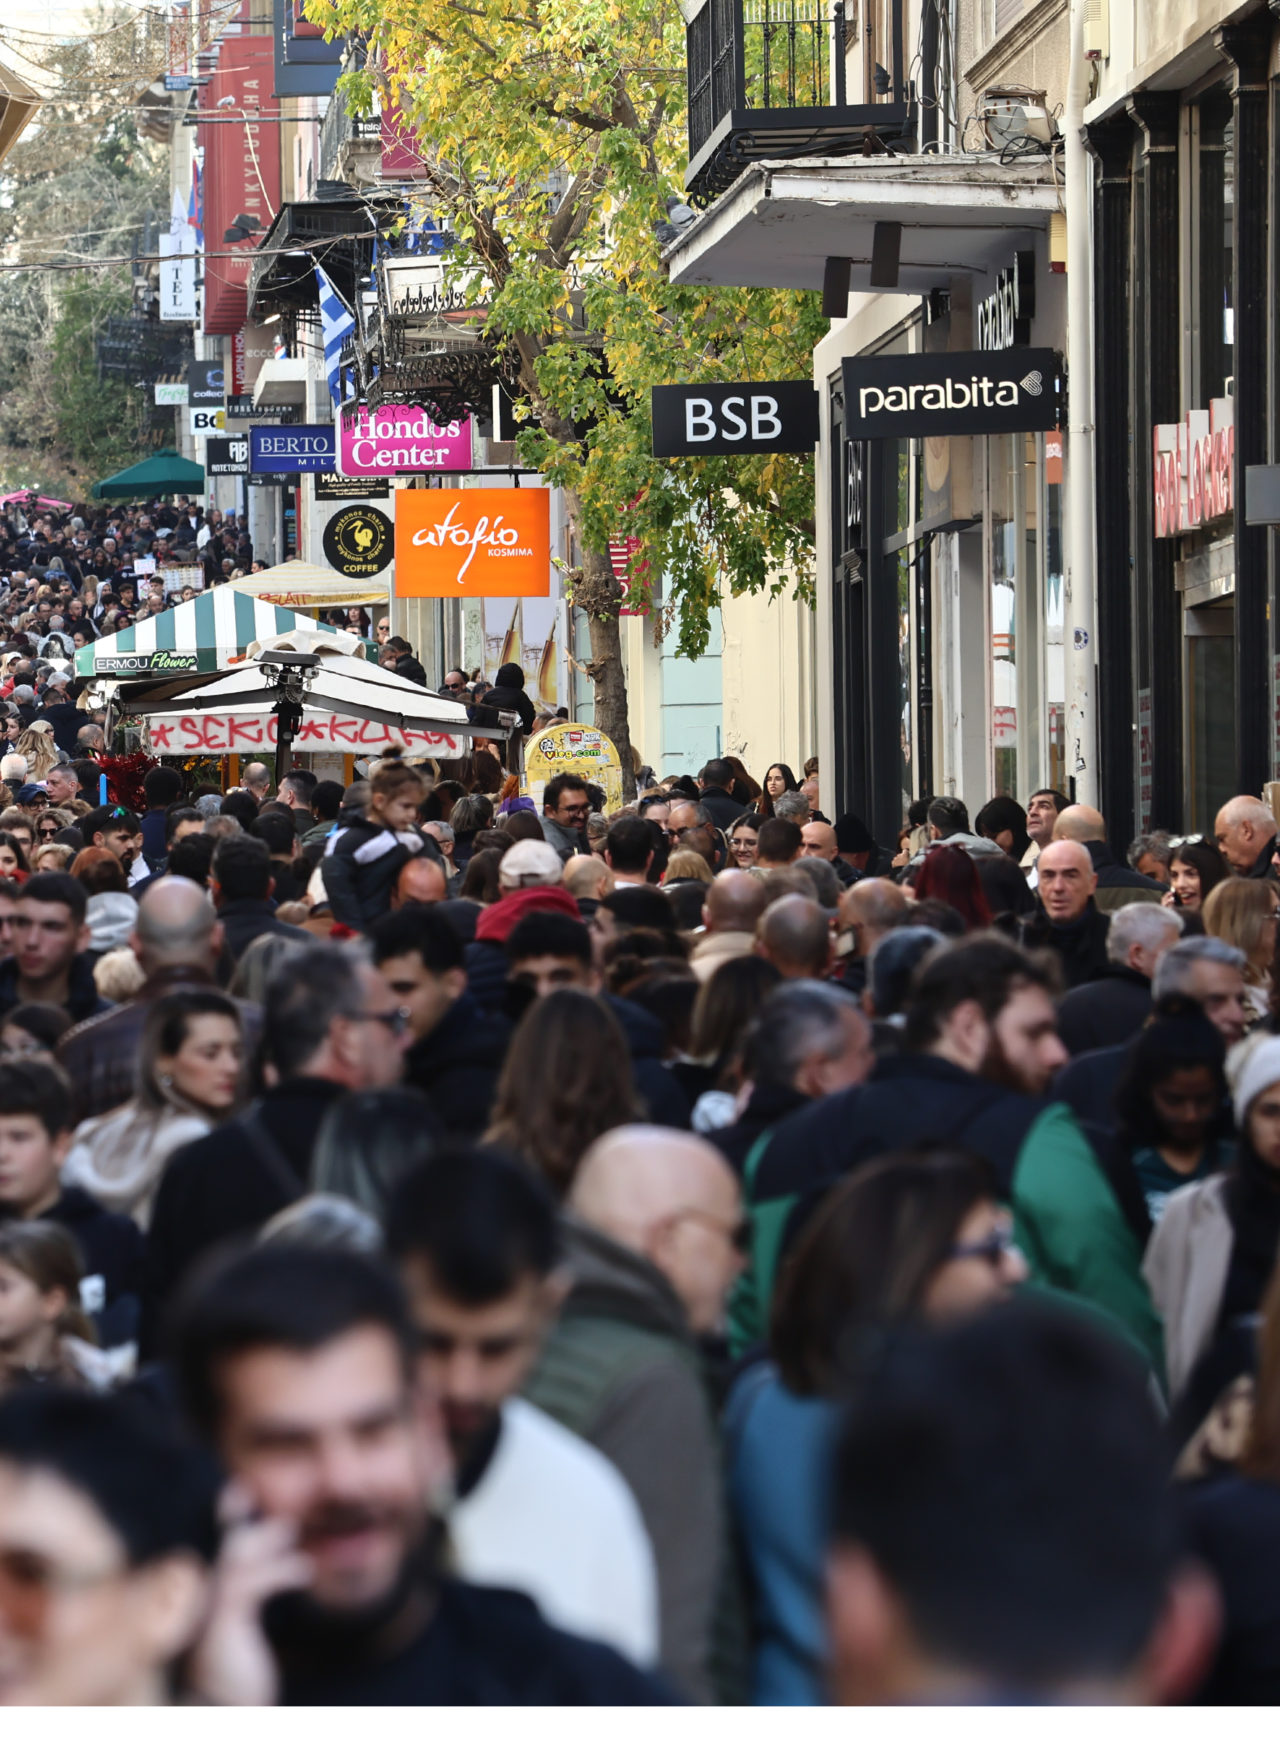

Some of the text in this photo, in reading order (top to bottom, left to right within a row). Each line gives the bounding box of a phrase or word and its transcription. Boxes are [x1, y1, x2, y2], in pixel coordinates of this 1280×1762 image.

[243, 79, 260, 221] NKYBUDDHA
[246, 349, 274, 358] ecco
[859, 376, 1019, 418] parabita
[352, 413, 461, 440] Hondos
[685, 395, 783, 442] BSB
[260, 437, 328, 453] BERTO
[352, 440, 450, 467] Center
[335, 511, 385, 533] mykonos charm
[367, 543, 384, 560] charm
[488, 548, 533, 557] KOSMIMA
[343, 564, 379, 573] COFFEE
[96, 651, 198, 670] ERMOU Flower
